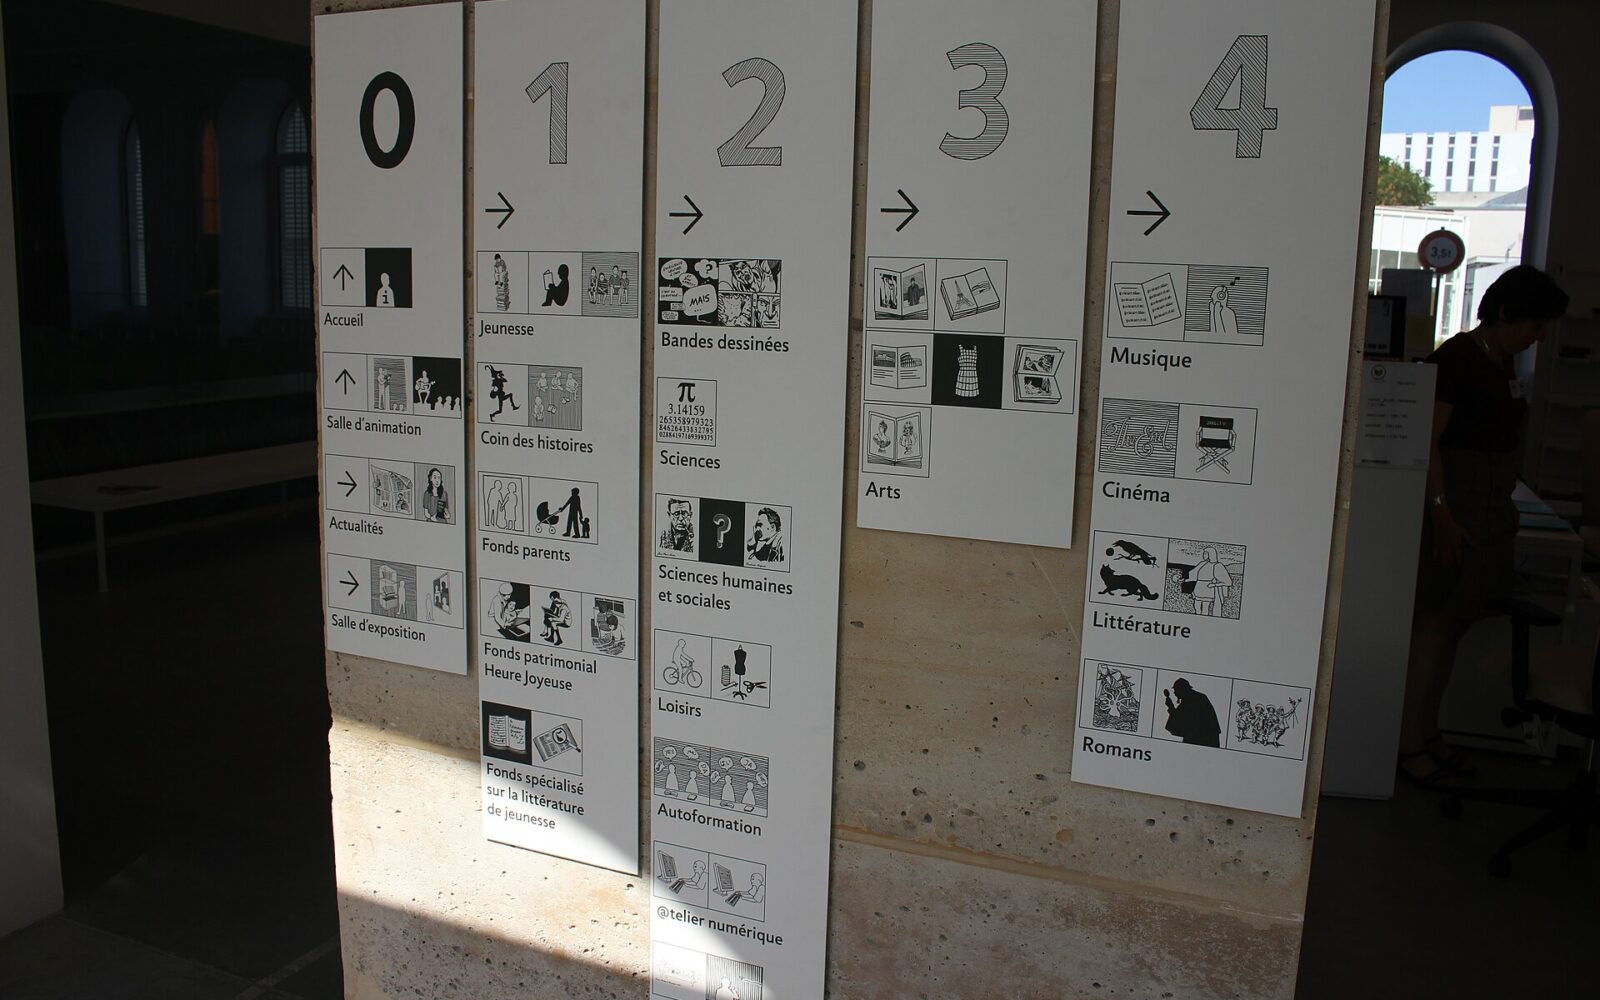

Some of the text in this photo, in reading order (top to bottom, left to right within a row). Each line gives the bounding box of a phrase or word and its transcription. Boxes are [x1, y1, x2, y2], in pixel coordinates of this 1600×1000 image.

[939, 42, 1009, 160] 3
[1189, 35, 1278, 158] 4
[359, 71, 415, 169] 0
[525, 62, 568, 164] 1
[717, 57, 786, 167] 2
[1430, 247, 1452, 259] 3,5t
[690, 294, 710, 306] MAIS
[324, 313, 363, 326] Accueil
[479, 320, 534, 337] Jeunesse
[662, 332, 789, 352] Bandes dessinées
[1111, 347, 1192, 371] Musique
[668, 403, 705, 416] 3.14159
[327, 415, 352, 430] Salle
[481, 431, 593, 453] Coin des histoires
[660, 450, 720, 469] Sciences
[865, 481, 900, 499] Arts
[1103, 481, 1170, 503] Cinéma
[329, 516, 383, 535] Actualités
[483, 538, 570, 562] Fonds parents
[659, 564, 792, 595] Sciences humaines
[659, 591, 730, 610] et sociales
[332, 614, 359, 631] Salle
[1093, 612, 1192, 638] Littérature
[485, 642, 598, 676] Fonds patrimonial
[485, 664, 572, 690] Heure Joyeuse
[659, 697, 701, 717] Loisirs
[1083, 737, 1152, 761] Romans
[487, 763, 584, 795] Fonds spécialisé
[487, 785, 585, 817] sur la littérature
[487, 803, 556, 831] de jeunesse
[658, 804, 762, 836] Autoformation
[657, 906, 784, 946] @telier numérique
